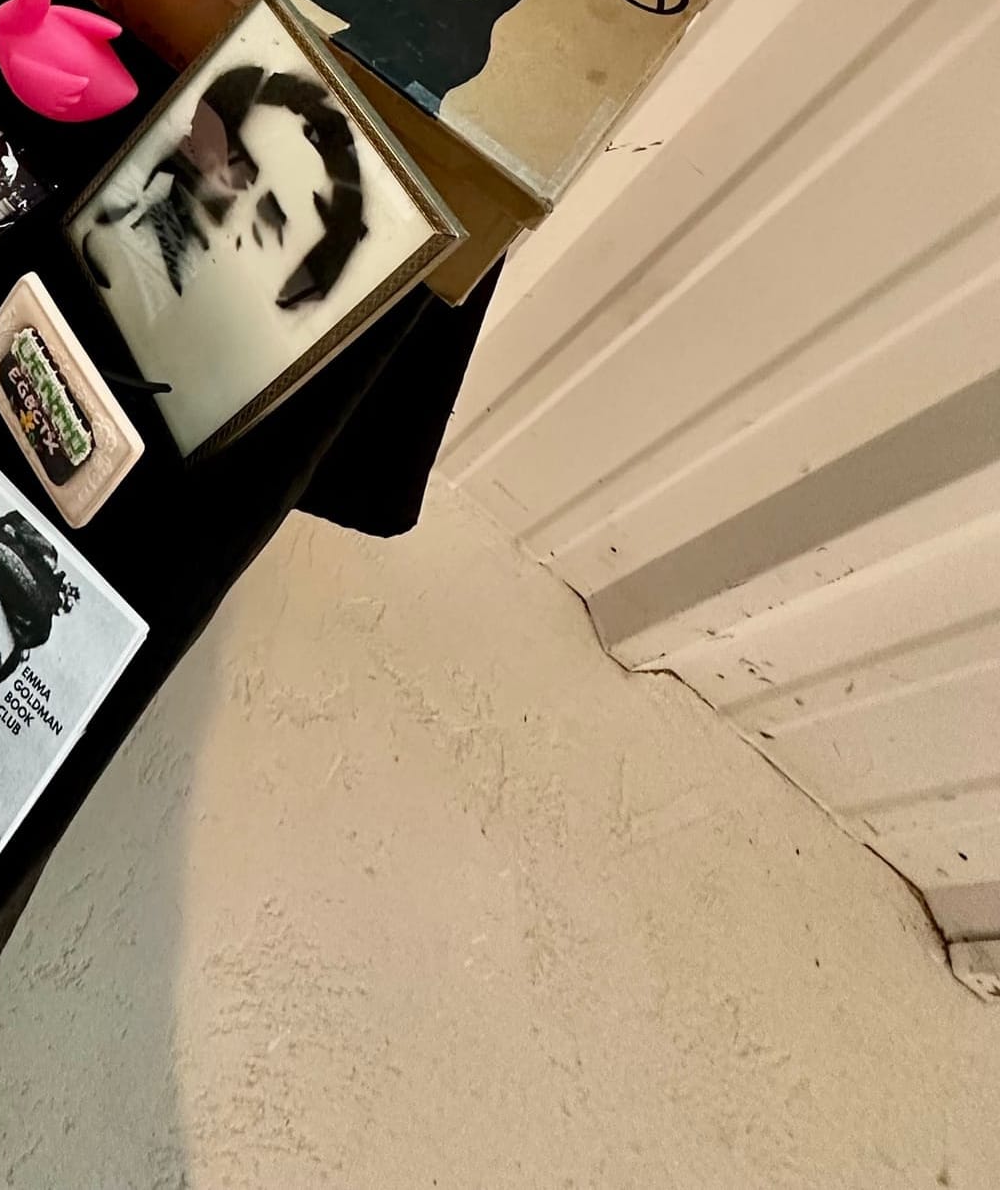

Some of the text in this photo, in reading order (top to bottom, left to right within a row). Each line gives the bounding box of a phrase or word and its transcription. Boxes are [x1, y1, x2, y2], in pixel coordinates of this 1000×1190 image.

[21, 666, 51, 702] EMMA
[4, 691, 35, 727] BOOK
[13, 679, 63, 736] GOLDMAN
